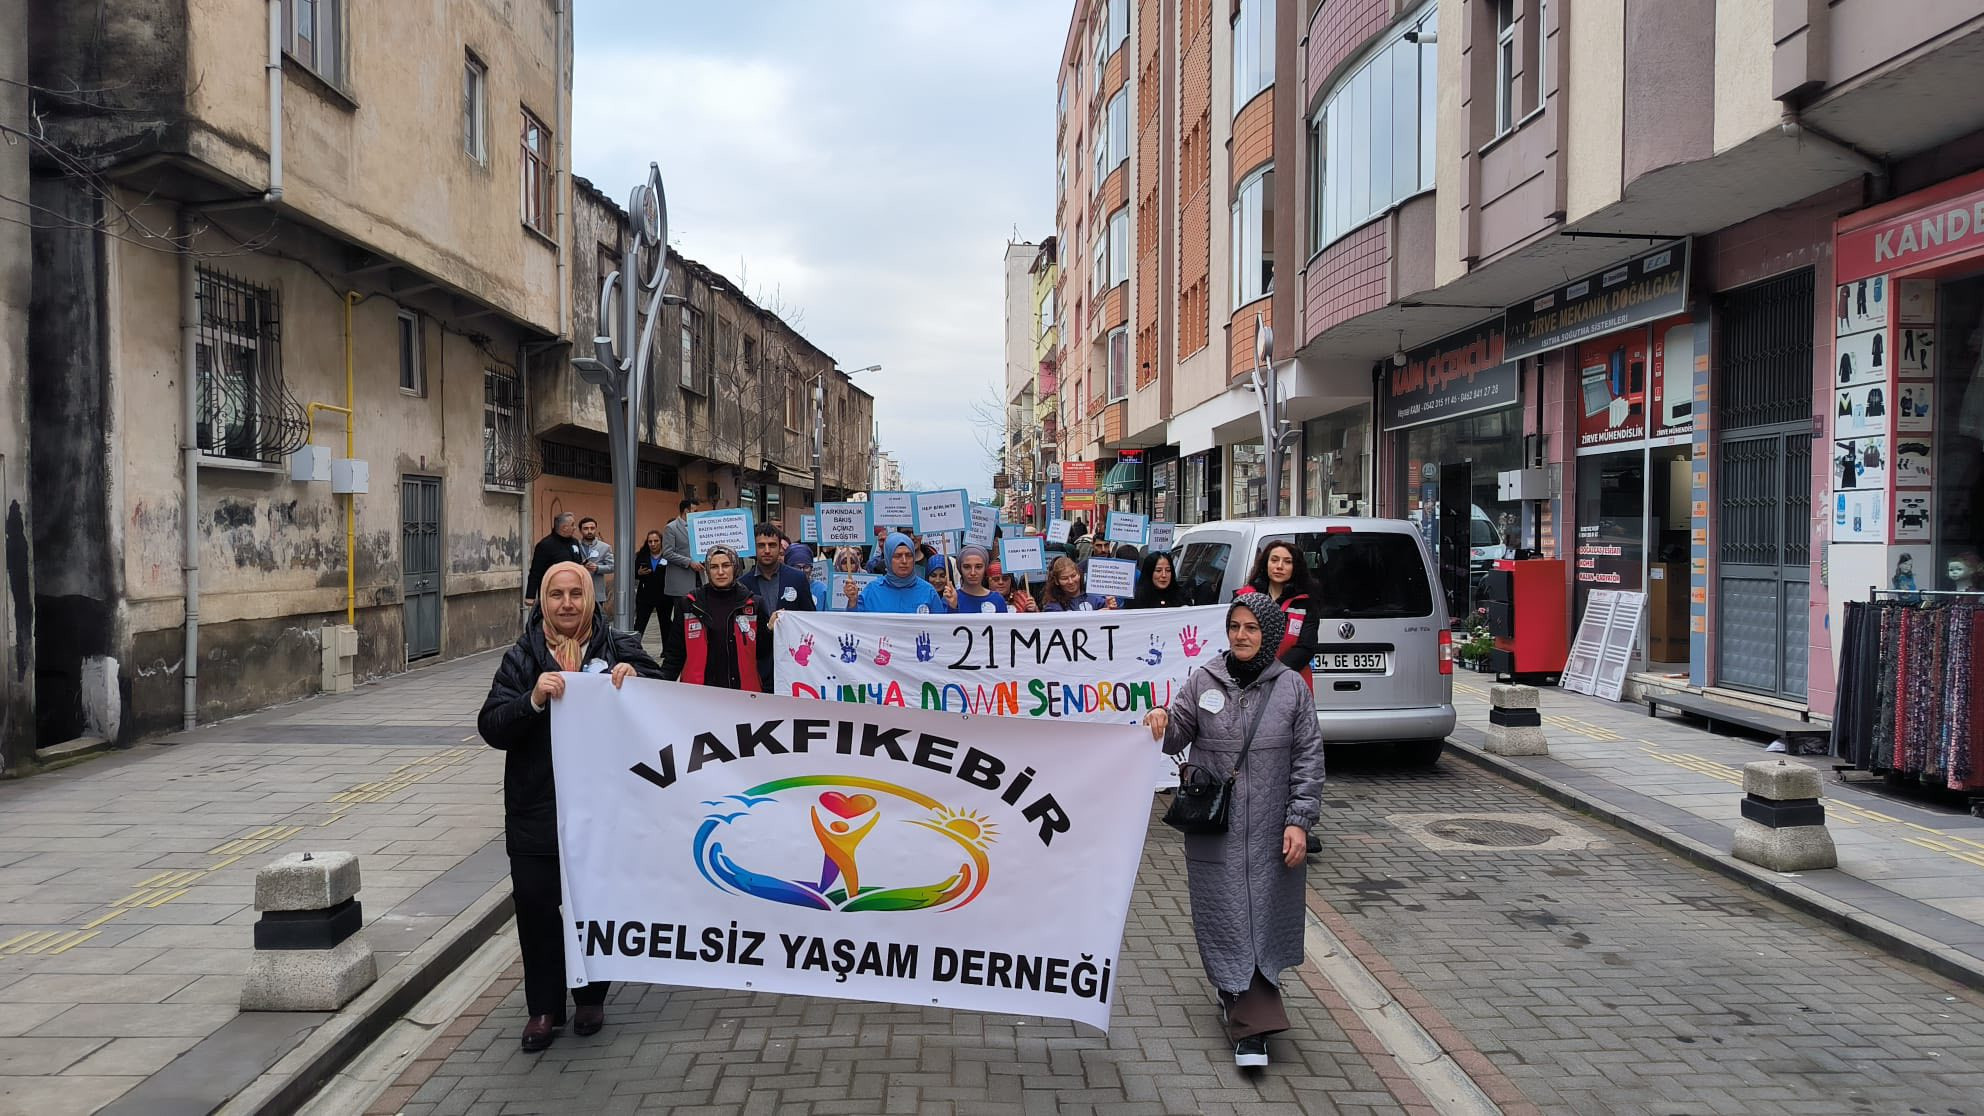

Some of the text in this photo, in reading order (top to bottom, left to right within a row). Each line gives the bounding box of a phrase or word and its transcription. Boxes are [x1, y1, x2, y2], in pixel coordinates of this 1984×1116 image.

[1529, 309, 1560, 337] ZİRVE
[1560, 291, 1608, 328] MEKANİK
[1612, 271, 1681, 311] DOĞALGAZ
[1561, 325, 1590, 341] SOĞUTMA
[1591, 314, 1628, 333] SİSTEMLERİ
[1582, 424, 1643, 444] ZİRVE MÜHENDİSLİK
[830, 532, 858, 540] DEĞİŞTİR
[948, 625, 1120, 670] 21 MART
[1314, 654, 1382, 668] 34 GE 8357
[921, 681, 1019, 716] DOWN
[1027, 678, 1170, 717] SENDROMU
[629, 718, 1072, 848] VAKFIKEBİR
[575, 920, 1111, 1004] NGELSİZ YAŞAM DERNEĞİ
